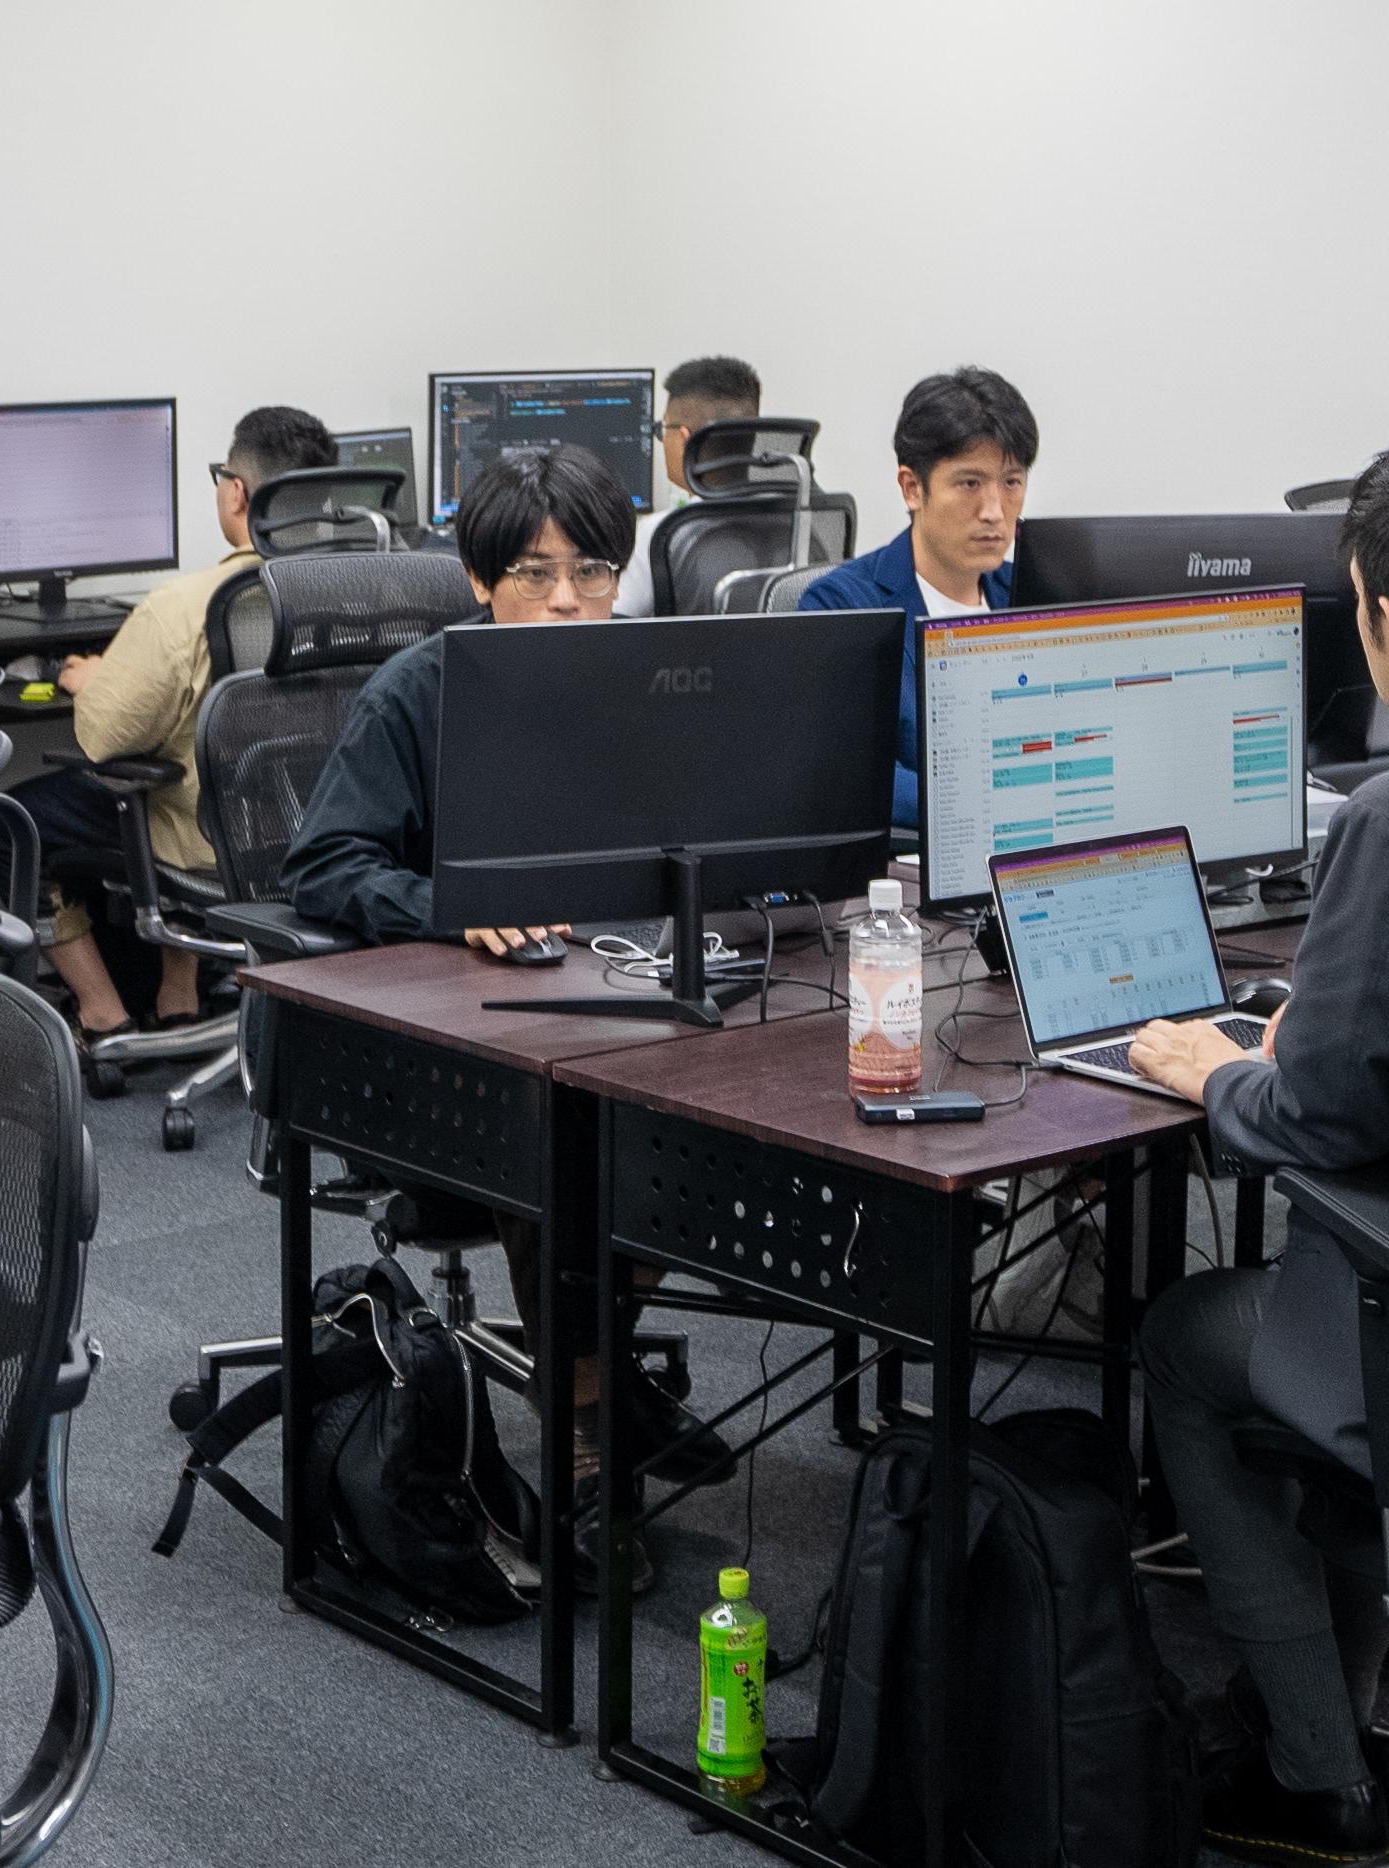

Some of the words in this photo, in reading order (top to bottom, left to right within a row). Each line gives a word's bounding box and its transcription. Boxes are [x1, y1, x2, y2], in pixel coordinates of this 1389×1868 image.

[1187, 552, 1252, 577] iiyama
[648, 667, 712, 694] AOC
[742, 1676, 761, 1725] お茶
